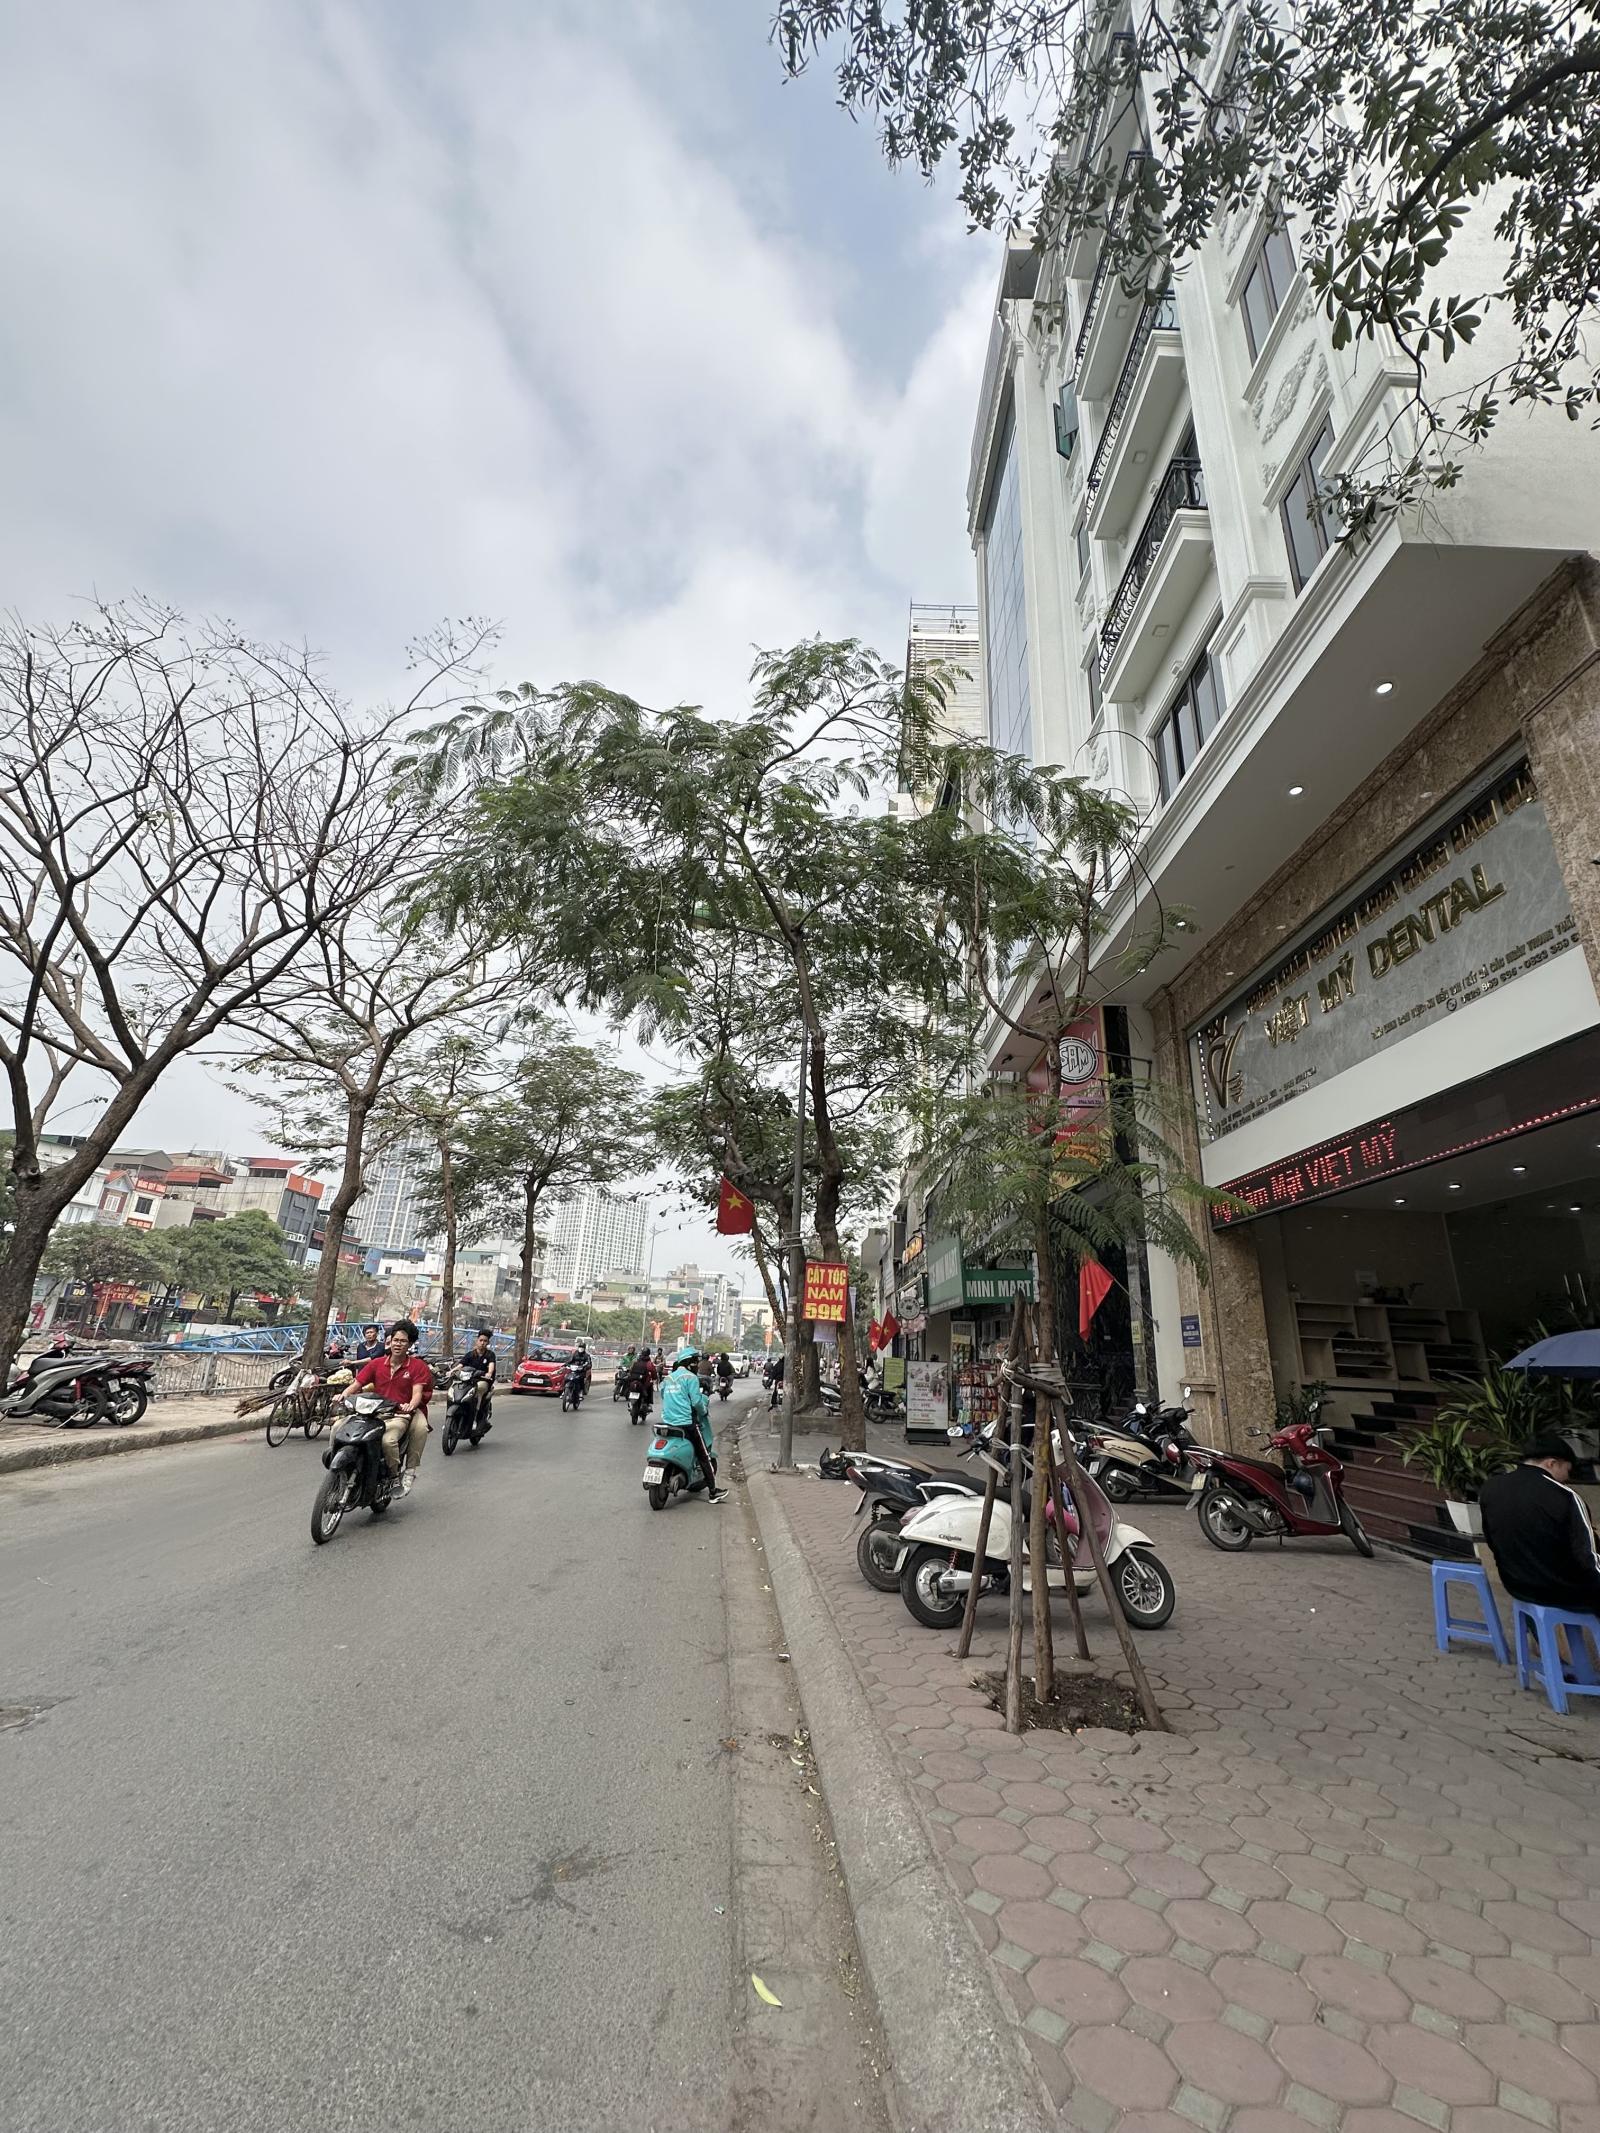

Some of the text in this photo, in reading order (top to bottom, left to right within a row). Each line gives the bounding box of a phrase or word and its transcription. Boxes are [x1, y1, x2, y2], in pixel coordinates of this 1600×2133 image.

[1264, 991, 1310, 1048] VIỆT
[1317, 951, 1356, 1013] MỸ
[1367, 863, 1507, 979] DENTAL
[1060, 1045, 1089, 1073] SAM
[1305, 1146, 1352, 1187] VIỆT
[1359, 1121, 1396, 1169] MỸ
[828, 1267, 846, 1286] TÓC
[807, 1287, 843, 1301] NAM
[966, 1280, 1031, 1298] MINI MART
[805, 1302, 843, 1320] 59K
